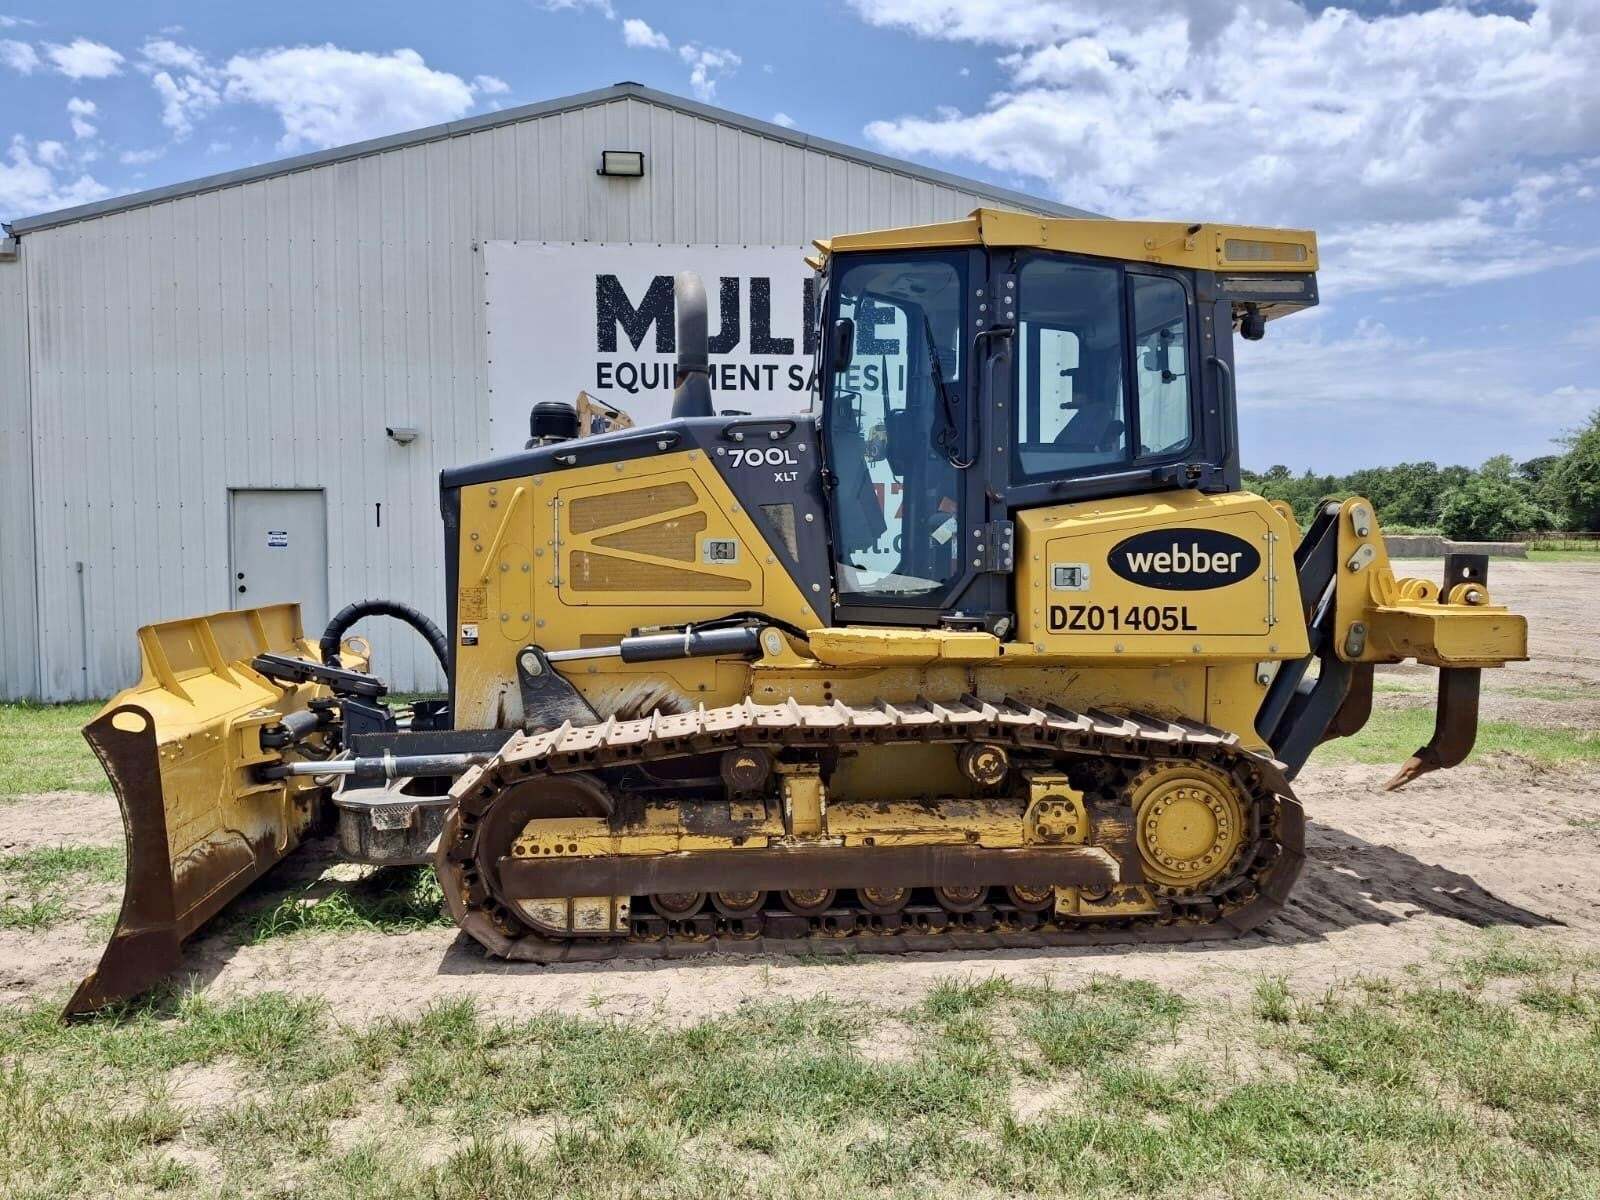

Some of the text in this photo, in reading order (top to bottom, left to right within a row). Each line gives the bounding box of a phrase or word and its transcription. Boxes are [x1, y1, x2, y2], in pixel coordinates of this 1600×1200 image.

[596, 274, 900, 355] MULE
[596, 362, 779, 394] EQUIENT
[788, 364, 880, 391] SAES
[728, 448, 798, 467] 700L
[774, 471, 798, 482] XLT
[1126, 542, 1242, 573] webber
[1050, 605, 1198, 631] DZ01405L
